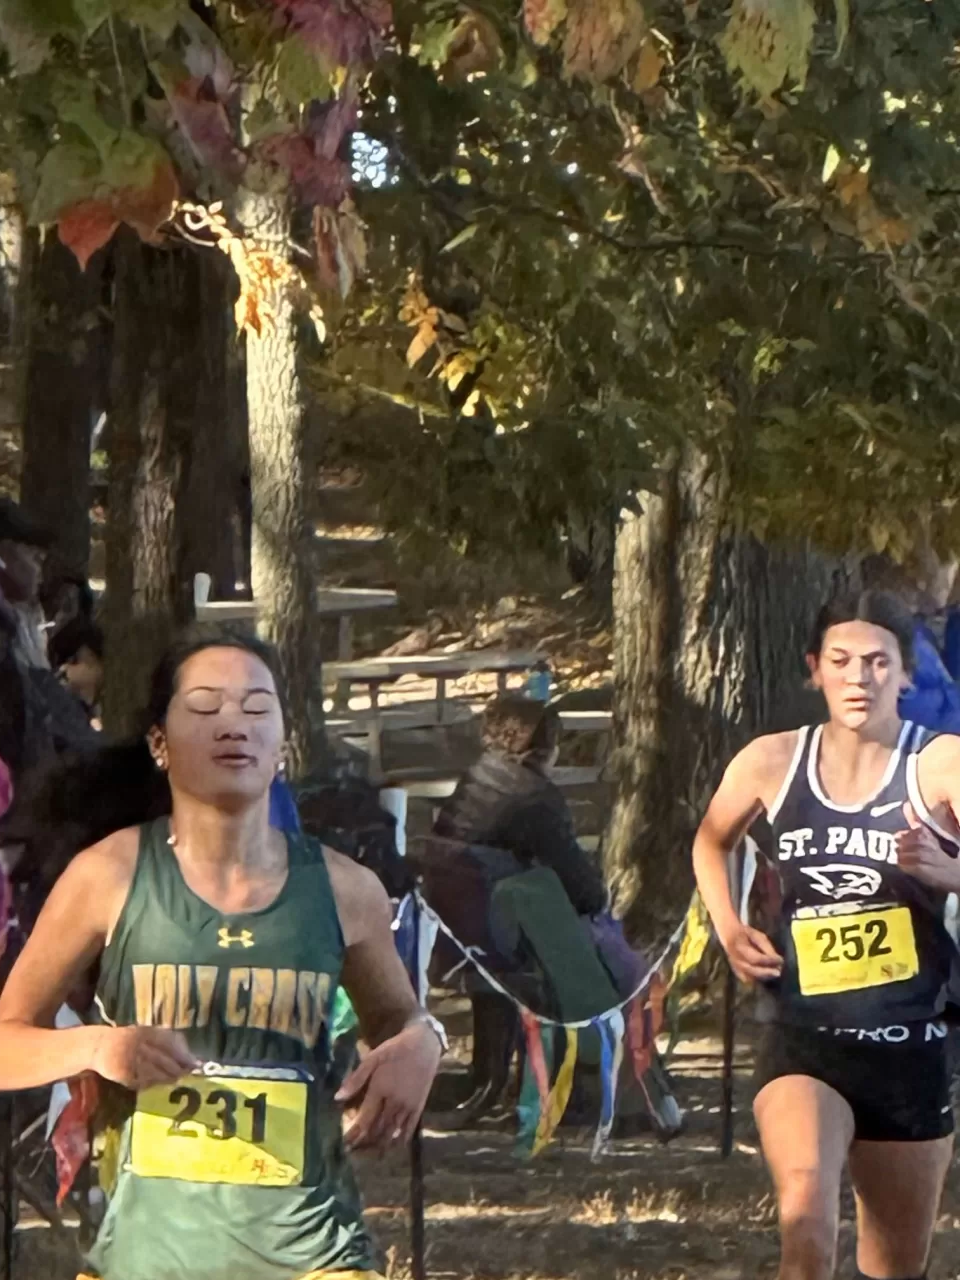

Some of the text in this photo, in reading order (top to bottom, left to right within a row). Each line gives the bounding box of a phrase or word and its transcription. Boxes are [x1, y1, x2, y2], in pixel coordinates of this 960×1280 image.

[778, 828, 818, 860] ST.
[815, 919, 893, 963] 252
[166, 1086, 268, 1144] 231
